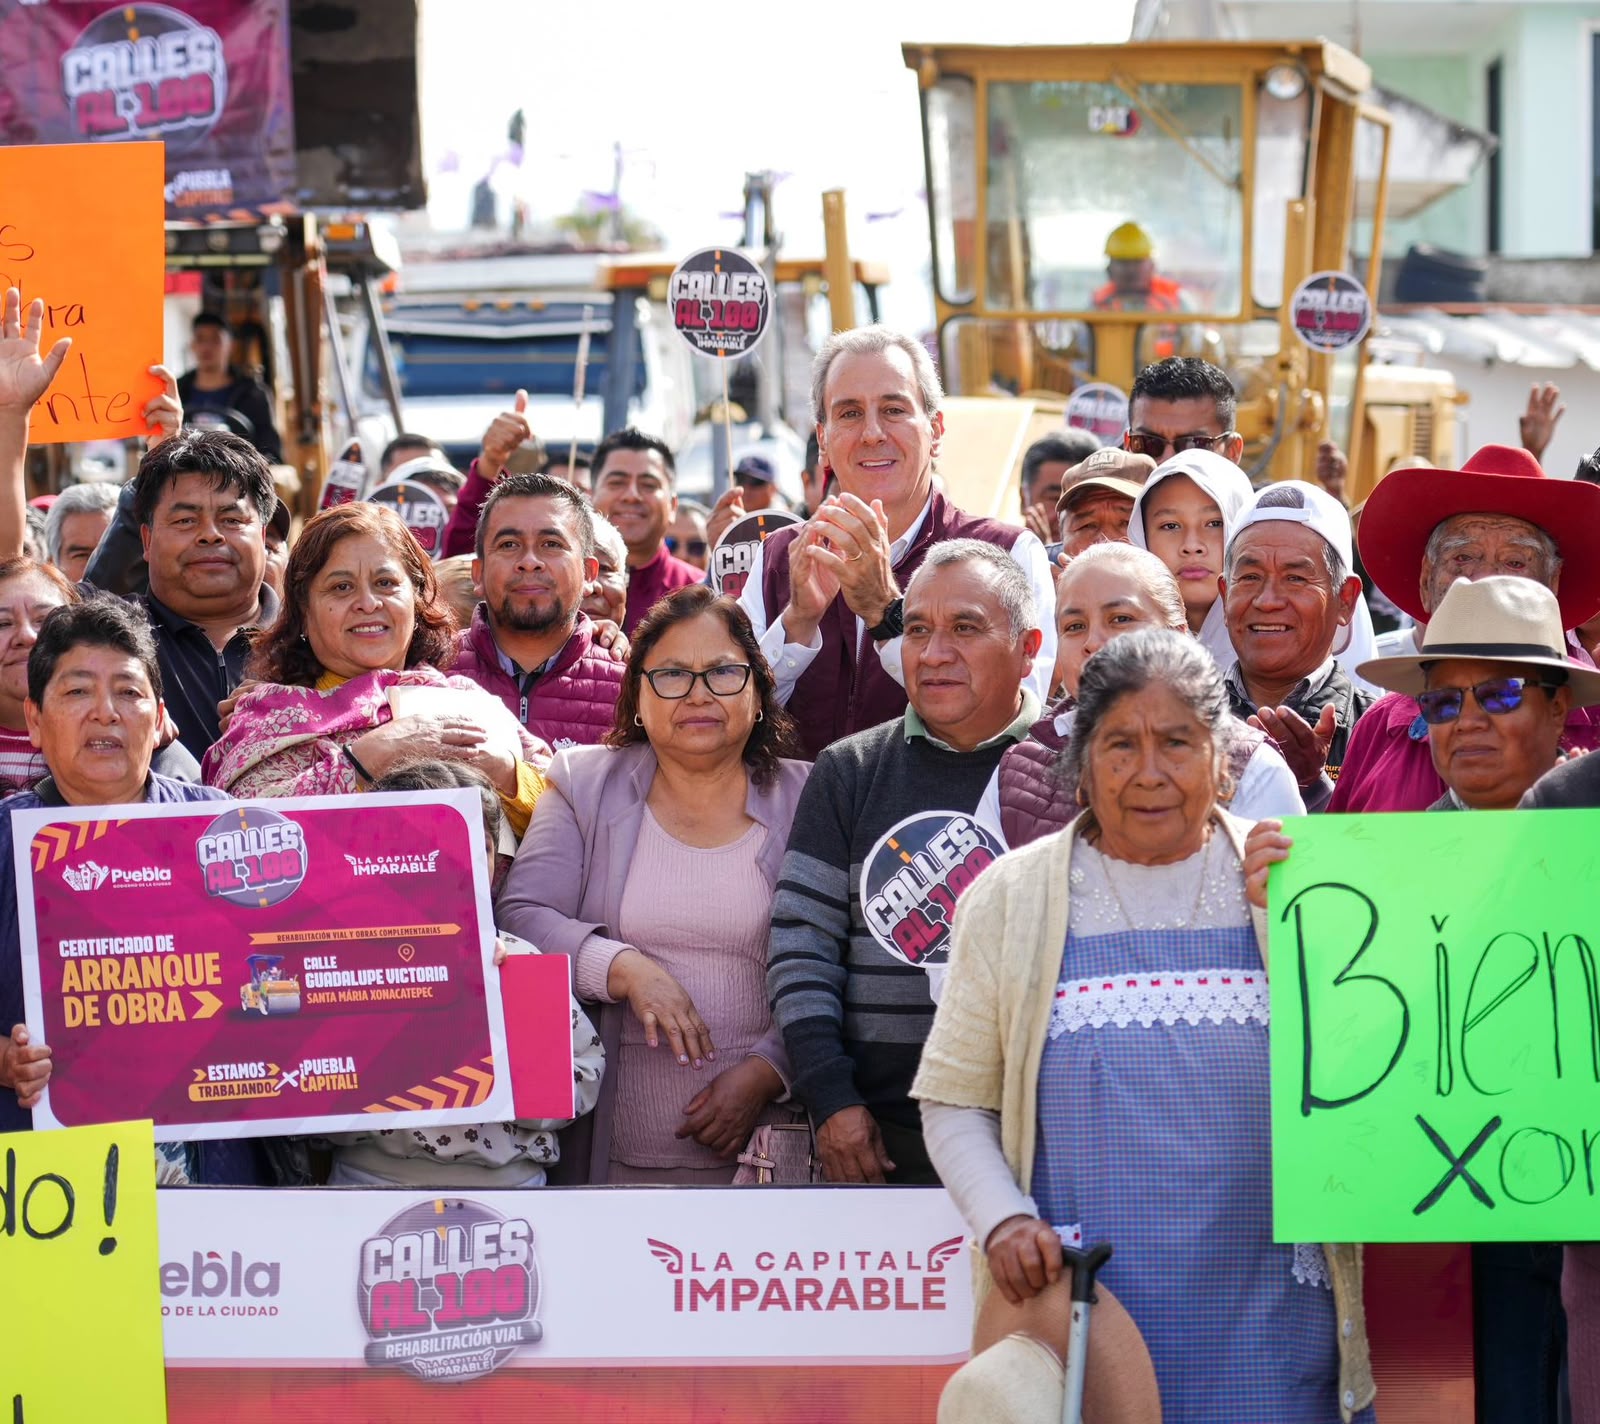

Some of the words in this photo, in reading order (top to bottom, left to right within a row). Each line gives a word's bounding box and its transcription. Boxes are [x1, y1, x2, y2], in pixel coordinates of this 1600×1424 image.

[63, 30, 217, 96] CALLES
[76, 91, 127, 134] AL
[134, 73, 214, 125] 100
[671, 272, 764, 302] CALLES
[675, 299, 706, 328] AL
[709, 300, 761, 330] 100
[697, 340, 745, 350] IMPARABLE
[1088, 452, 1116, 466] CAT
[715, 541, 761, 578] CAL
[197, 822, 303, 864] CALLES
[206, 860, 241, 892] AL
[244, 849, 302, 884] 100
[353, 862, 437, 876] IMPARABLE
[358, 857, 372, 865] LA
[377, 854, 428, 863] CAPITAL
[111, 866, 171, 883] Puebla
[865, 816, 982, 938] CALLES
[59, 936, 154, 957] CERTIFICADO
[158, 935, 175, 951] DE
[277, 931, 331, 942] REHABILITACIÓN
[333, 931, 347, 939] VIAL
[349, 930, 354, 938] Y
[355, 929, 378, 937] OBRAS
[379, 927, 441, 936] COMPLEMENTARIAS
[892, 908, 949, 964] AL
[62, 952, 222, 993] ARRANQUE
[304, 956, 337, 970] CALLE
[305, 969, 384, 988] GUADALUPE
[386, 966, 449, 983] VICTORIA
[307, 991, 336, 1004] SANTA
[370, 987, 433, 1000] XONACATEPEC
[1282, 881, 1600, 1117] Bien
[64, 995, 100, 1028] DE
[107, 990, 186, 1025] OBRA
[207, 1062, 266, 1081] ESTAMOS
[299, 1056, 356, 1080] ¡PUEBLA
[198, 1081, 272, 1099] TRABAJANDO
[301, 1073, 358, 1093] CAPITAL!
[362, 1220, 532, 1286] CALLES
[691, 1252, 734, 1272] LA
[755, 1250, 922, 1272] CAPITAL
[160, 1250, 281, 1298] ebla
[371, 1278, 429, 1331] AL
[434, 1264, 528, 1323] 100
[673, 1276, 947, 1312] IMPARABLE
[175, 1306, 194, 1316] DE
[198, 1306, 216, 1316] LA
[220, 1306, 278, 1316] CIUDAD
[385, 1330, 492, 1360] REHABILITACIÓN
[494, 1325, 524, 1344] VIAL
[424, 1361, 489, 1378] IMPARABLE
[443, 1356, 483, 1366] CAPITAL
